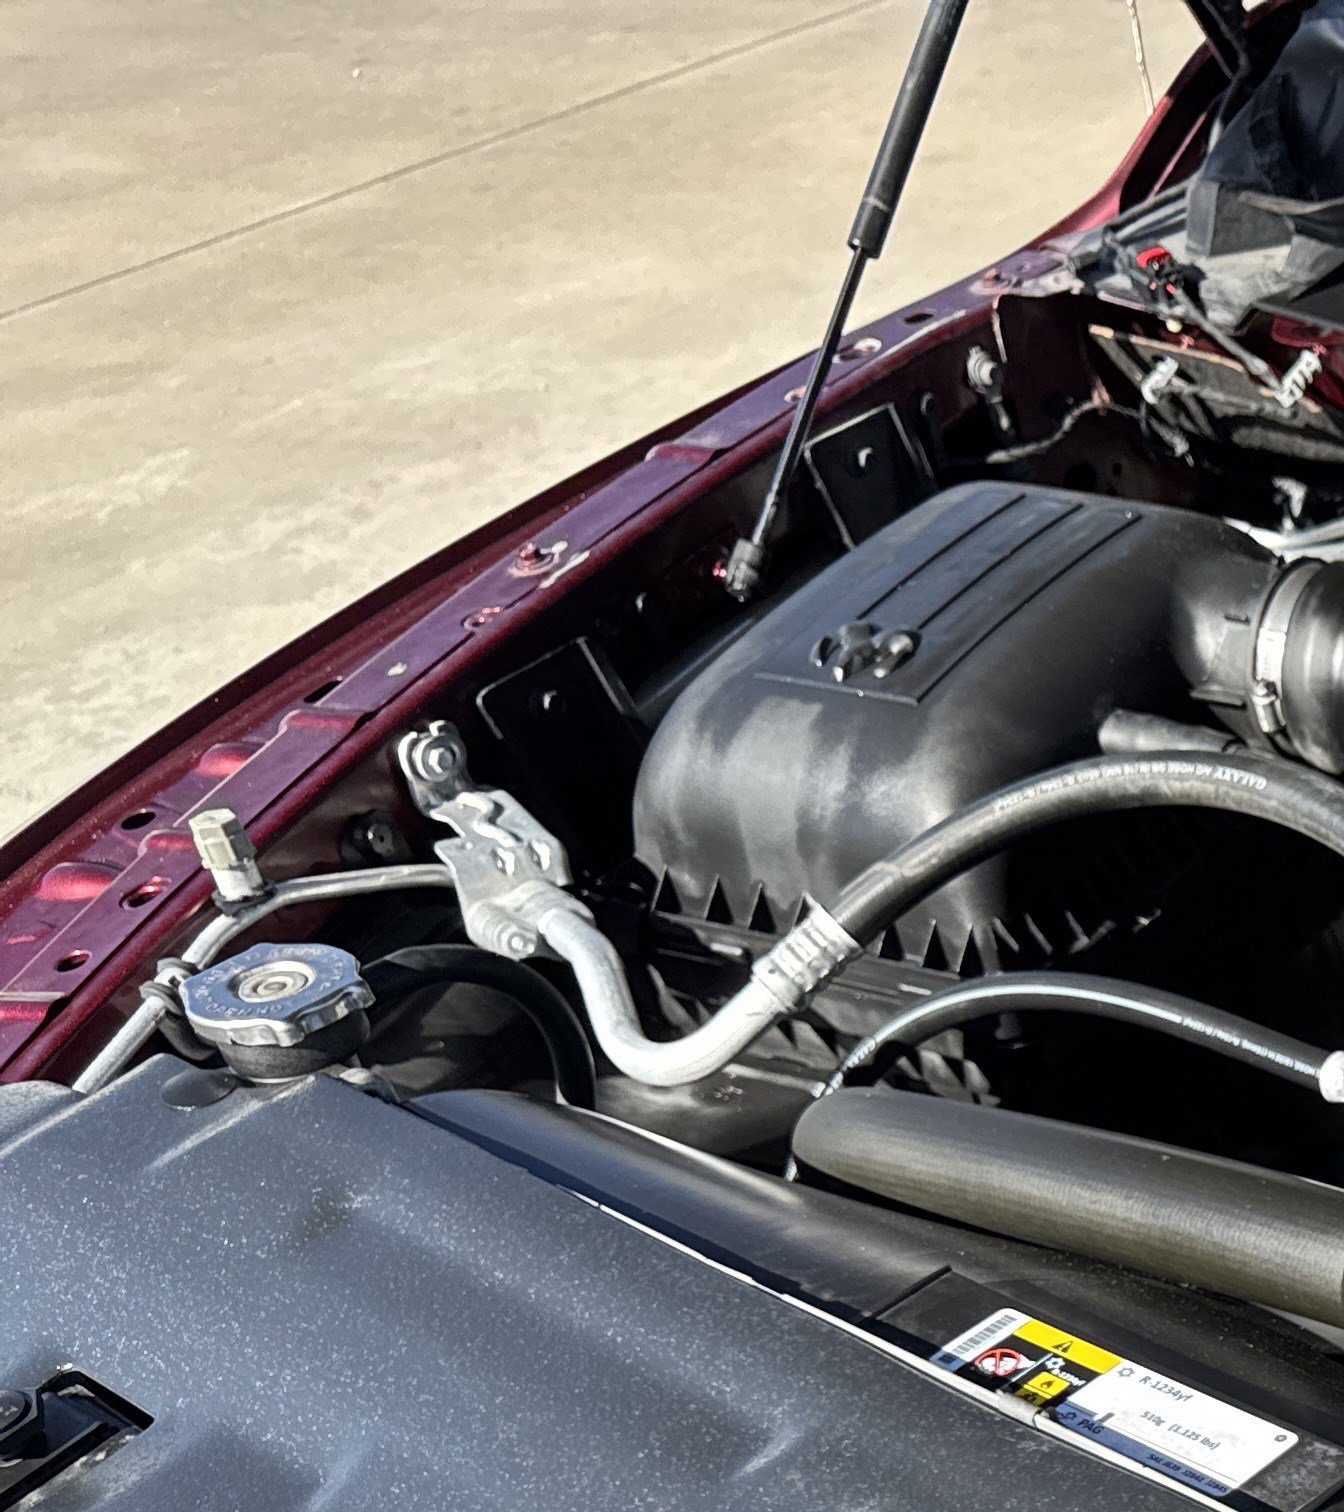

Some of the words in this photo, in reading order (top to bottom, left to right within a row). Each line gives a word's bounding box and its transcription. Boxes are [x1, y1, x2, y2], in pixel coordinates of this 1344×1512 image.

[1138, 1374, 1195, 1404] R-1234yf
[1077, 1418, 1106, 1436] PAG
[1140, 1410, 1167, 1428] 510g
